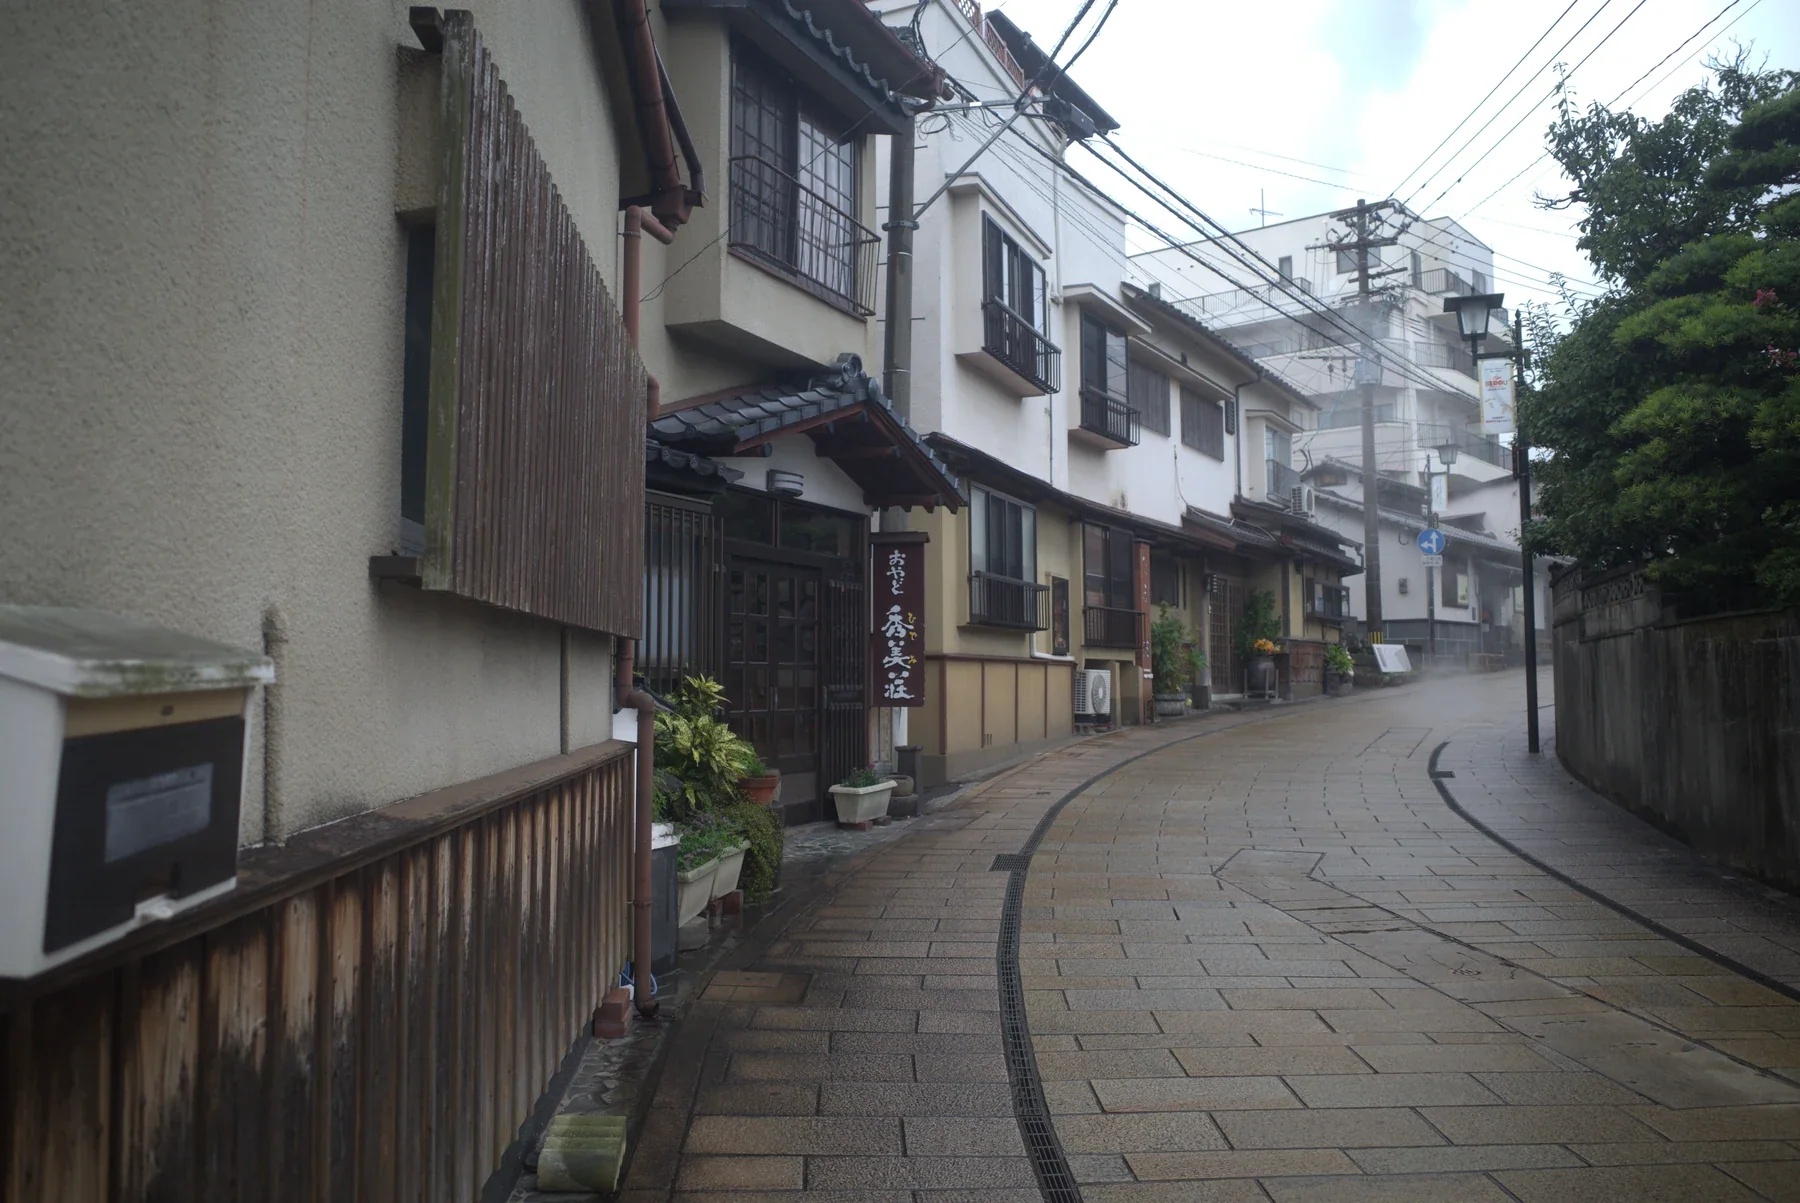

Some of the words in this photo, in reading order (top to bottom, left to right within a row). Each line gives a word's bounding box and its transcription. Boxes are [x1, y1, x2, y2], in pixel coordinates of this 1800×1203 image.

[886, 549, 906, 595] おやど
[881, 604, 915, 699] 秀美荘
[907, 612, 918, 664] ひでみ
